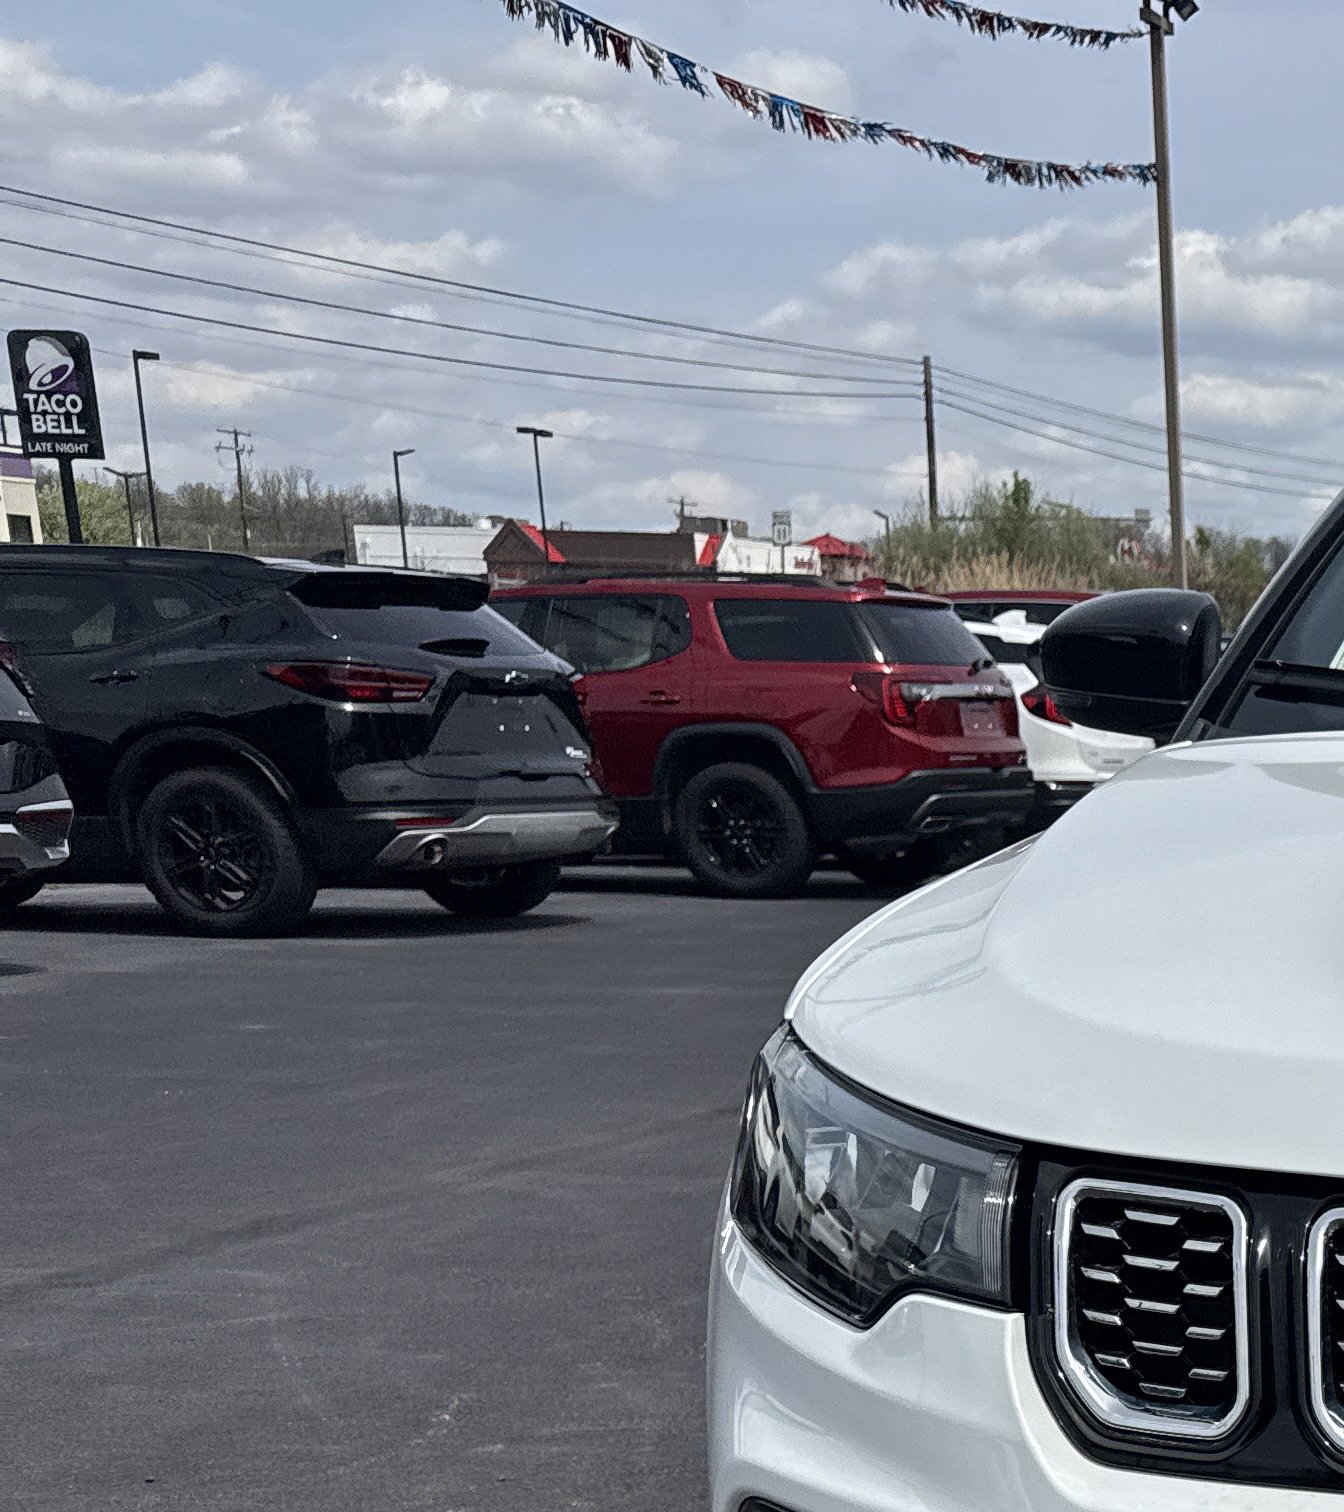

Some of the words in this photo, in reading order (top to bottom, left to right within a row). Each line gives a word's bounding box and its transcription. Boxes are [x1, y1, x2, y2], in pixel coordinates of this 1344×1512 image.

[23, 393, 83, 413] TACO
[31, 414, 86, 434] BELL
[28, 442, 54, 453] LATE
[55, 442, 89, 454] NIGHT
